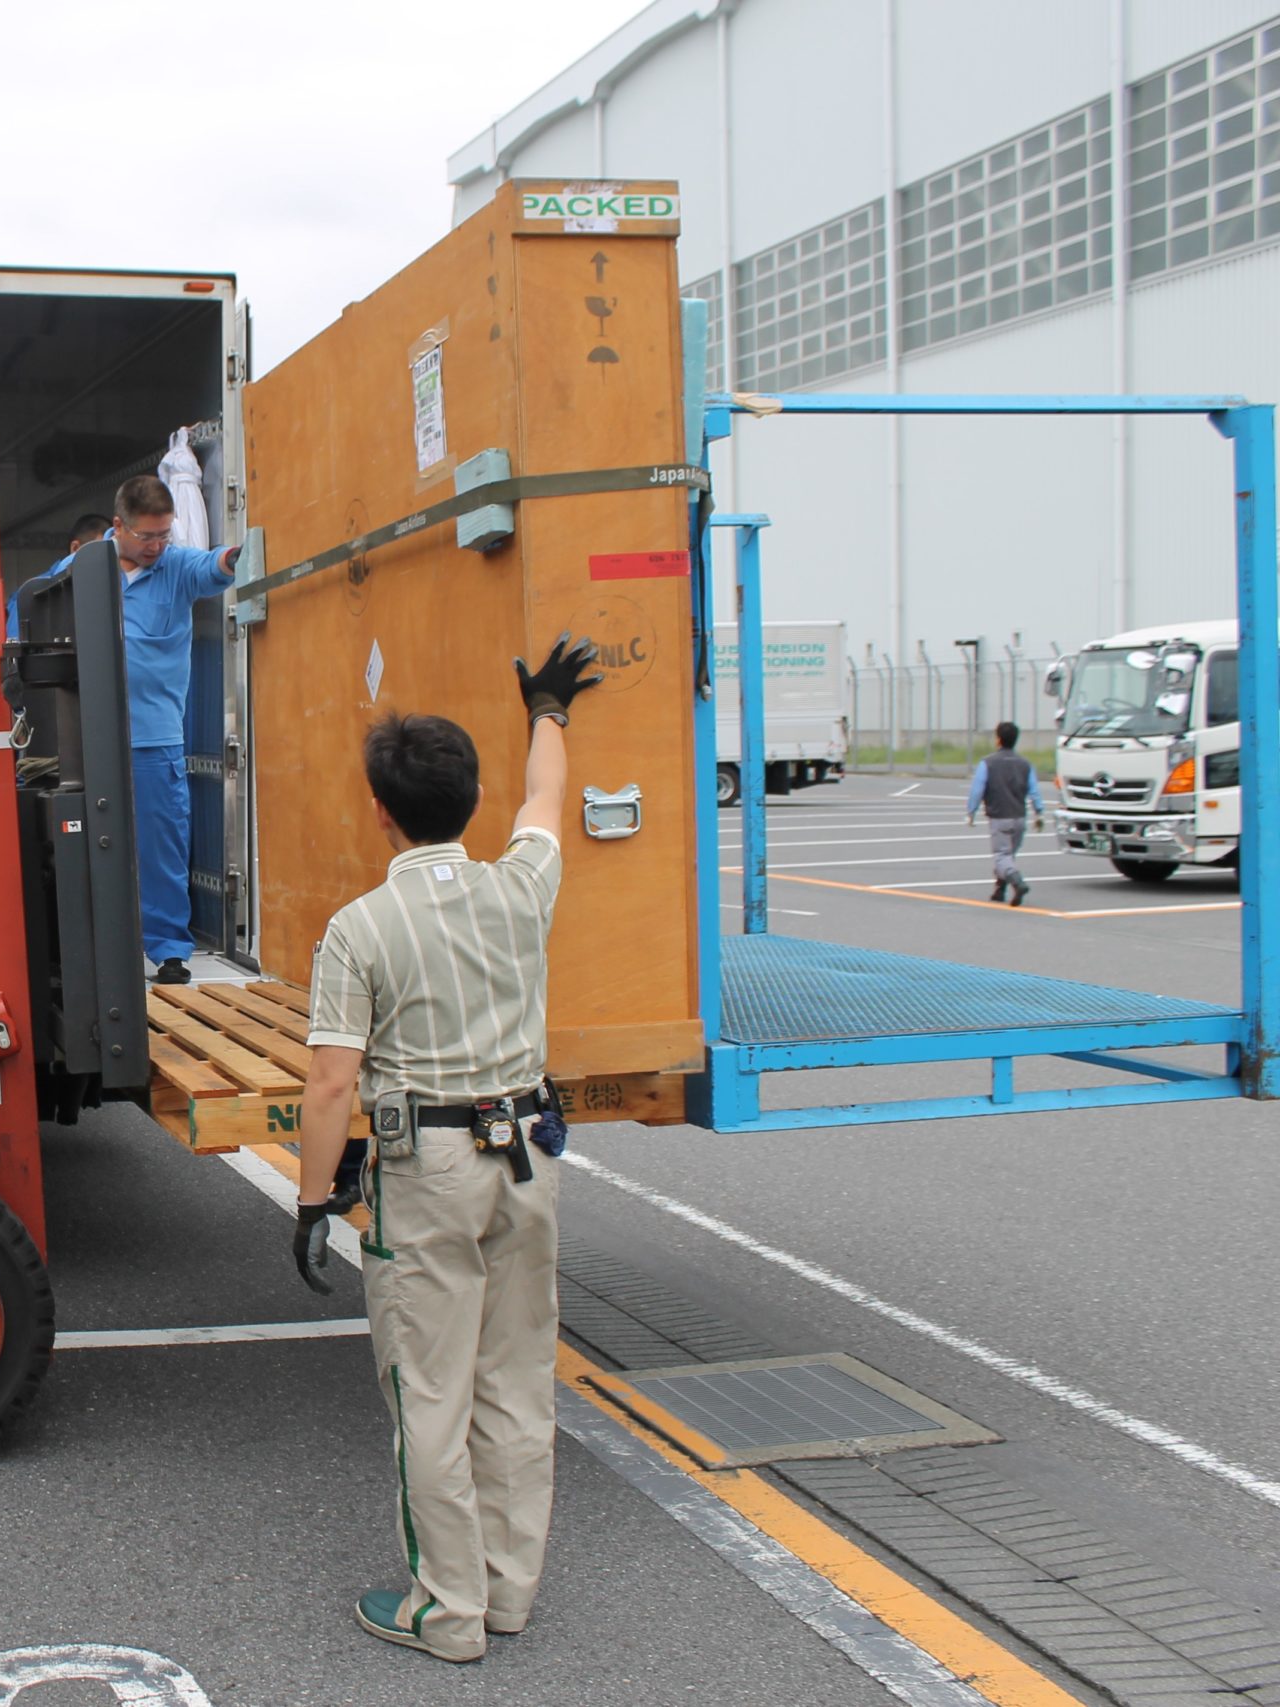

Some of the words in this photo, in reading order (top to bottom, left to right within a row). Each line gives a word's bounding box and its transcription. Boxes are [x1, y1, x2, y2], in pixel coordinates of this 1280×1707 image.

[523, 195, 673, 217] PACKED
[649, 466, 690, 484] Japan
[714, 643, 826, 655] USNSION
[714, 656, 826, 668] ONIONING
